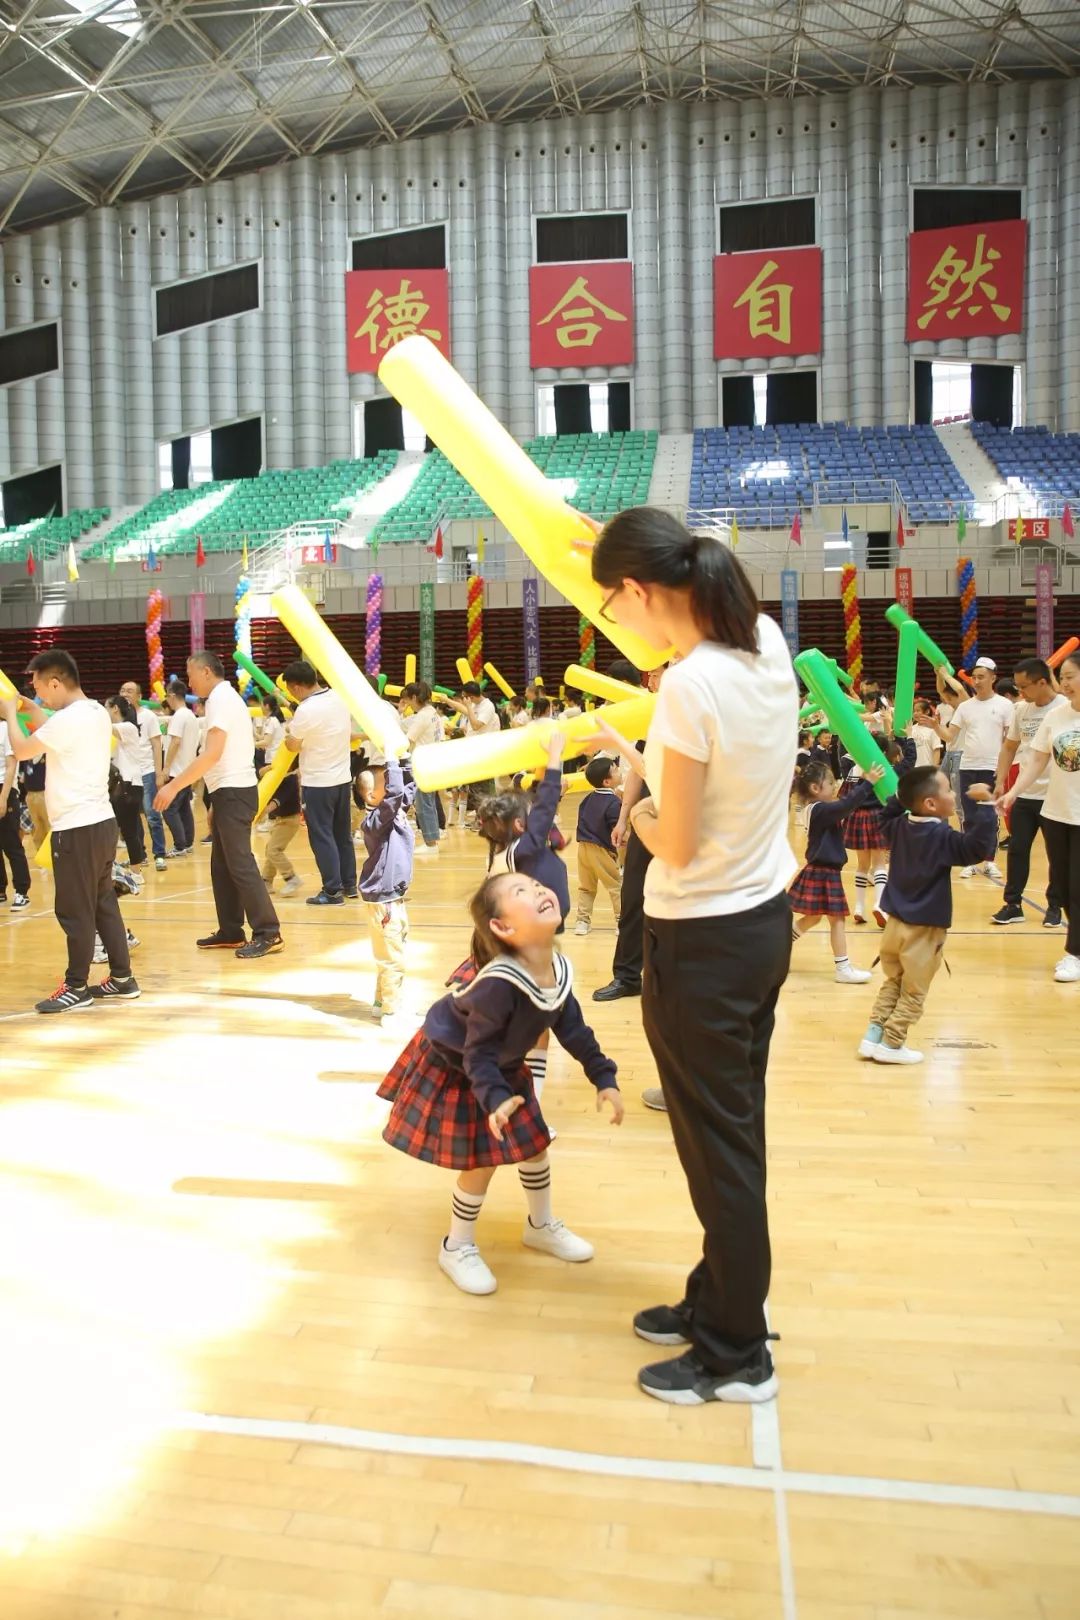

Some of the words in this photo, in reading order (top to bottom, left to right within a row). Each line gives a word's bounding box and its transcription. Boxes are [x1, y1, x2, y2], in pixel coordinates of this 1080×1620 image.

[354, 279, 442, 354] 德
[536, 276, 628, 349] 合
[733, 260, 794, 344] 自
[917, 234, 1012, 329] 然
[525, 582, 537, 639] 人小志气大
